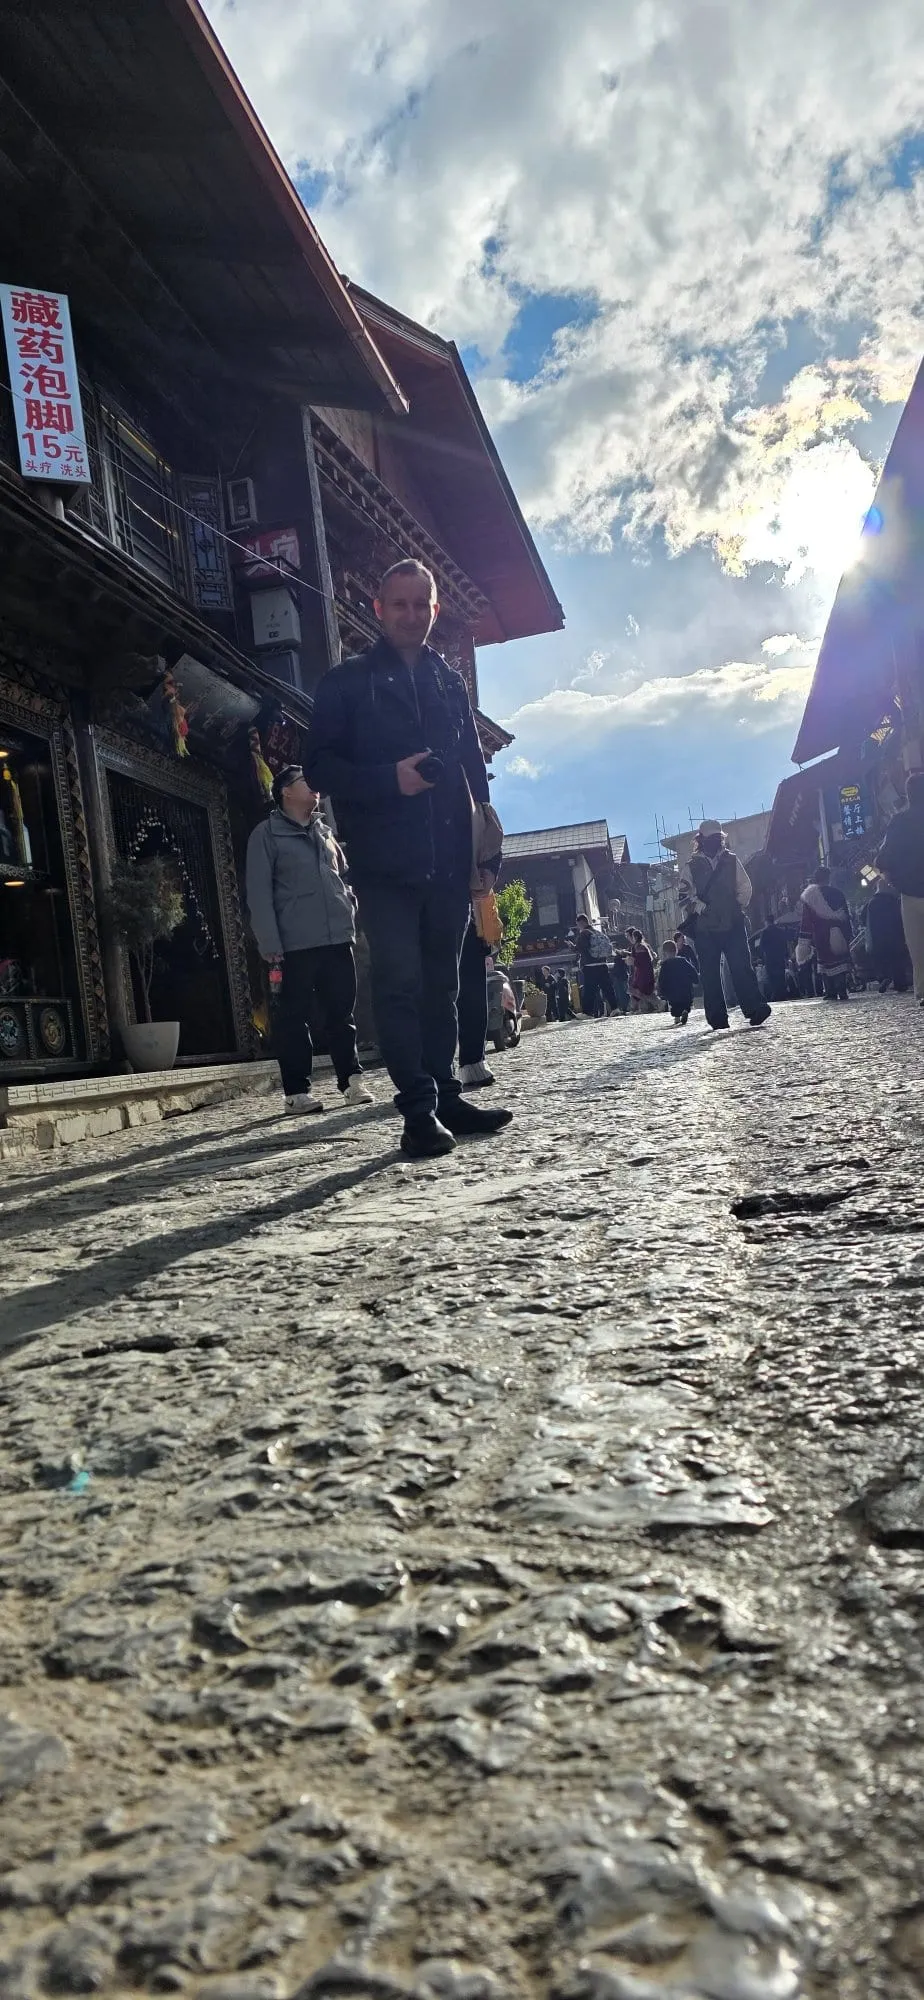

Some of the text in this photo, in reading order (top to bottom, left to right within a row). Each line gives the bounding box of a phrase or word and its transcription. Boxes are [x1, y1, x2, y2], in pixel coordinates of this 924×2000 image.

[10, 291, 74, 435] 藏药泡脚
[22, 433, 84, 462] 15元
[25, 459, 52, 474] 头疗
[60, 463, 87, 478] 洗头
